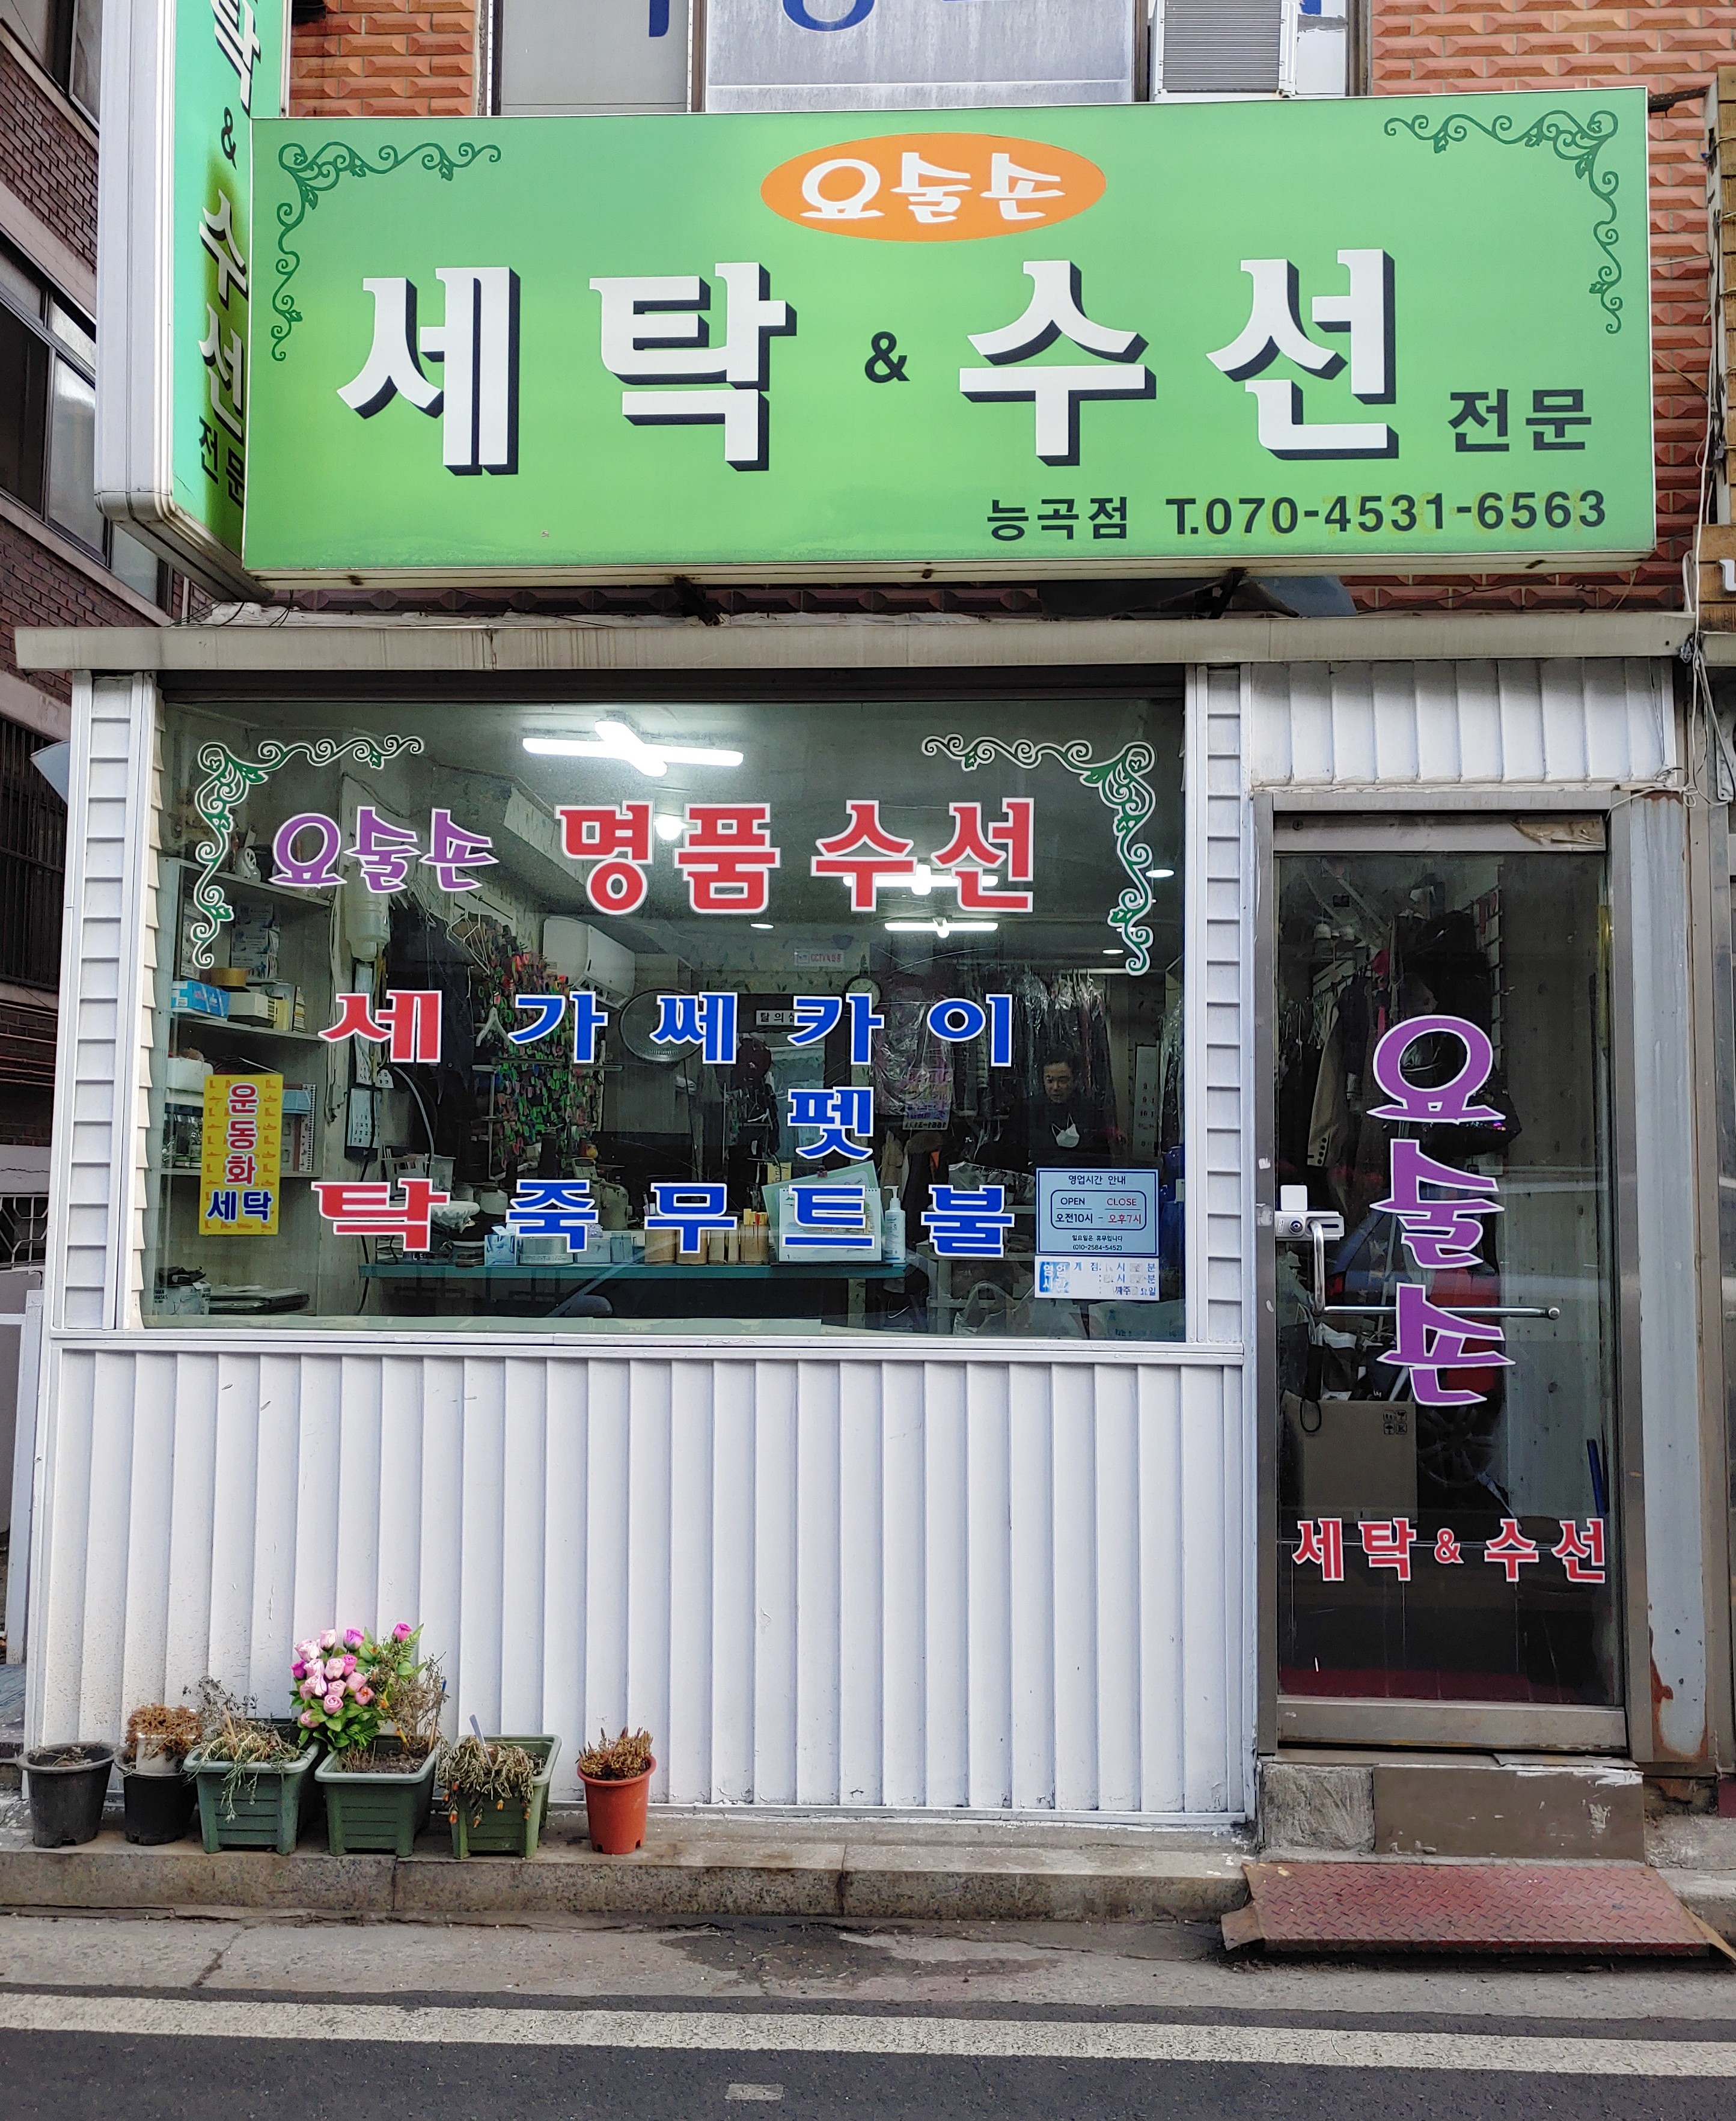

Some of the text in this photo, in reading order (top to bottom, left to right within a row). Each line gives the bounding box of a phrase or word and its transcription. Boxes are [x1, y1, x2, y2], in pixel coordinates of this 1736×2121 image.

[221, 106, 237, 171] &
[799, 151, 1065, 224] 요술손
[198, 188, 249, 447] 수선
[337, 248, 1593, 476] 세탁 & 수선 전문
[986, 489, 1607, 540] 능곡점 T.070-4531-6563
[268, 806, 500, 893] 요술손
[555, 797, 1035, 915] 명품 수선
[225, 1082, 259, 1186] 운동화
[206, 1189, 274, 1222] 세탁
[1060, 1197, 1137, 1206] OPEN CLOSE
[1068, 1175, 1126, 1185] 영업시간 안내
[1366, 1015, 1517, 1406] 요술손
[1055, 1213, 1093, 1224] 오전10시
[1108, 1213, 1142, 1225] 오후7시
[1292, 1516, 1606, 1584] 세탁 & 수선
